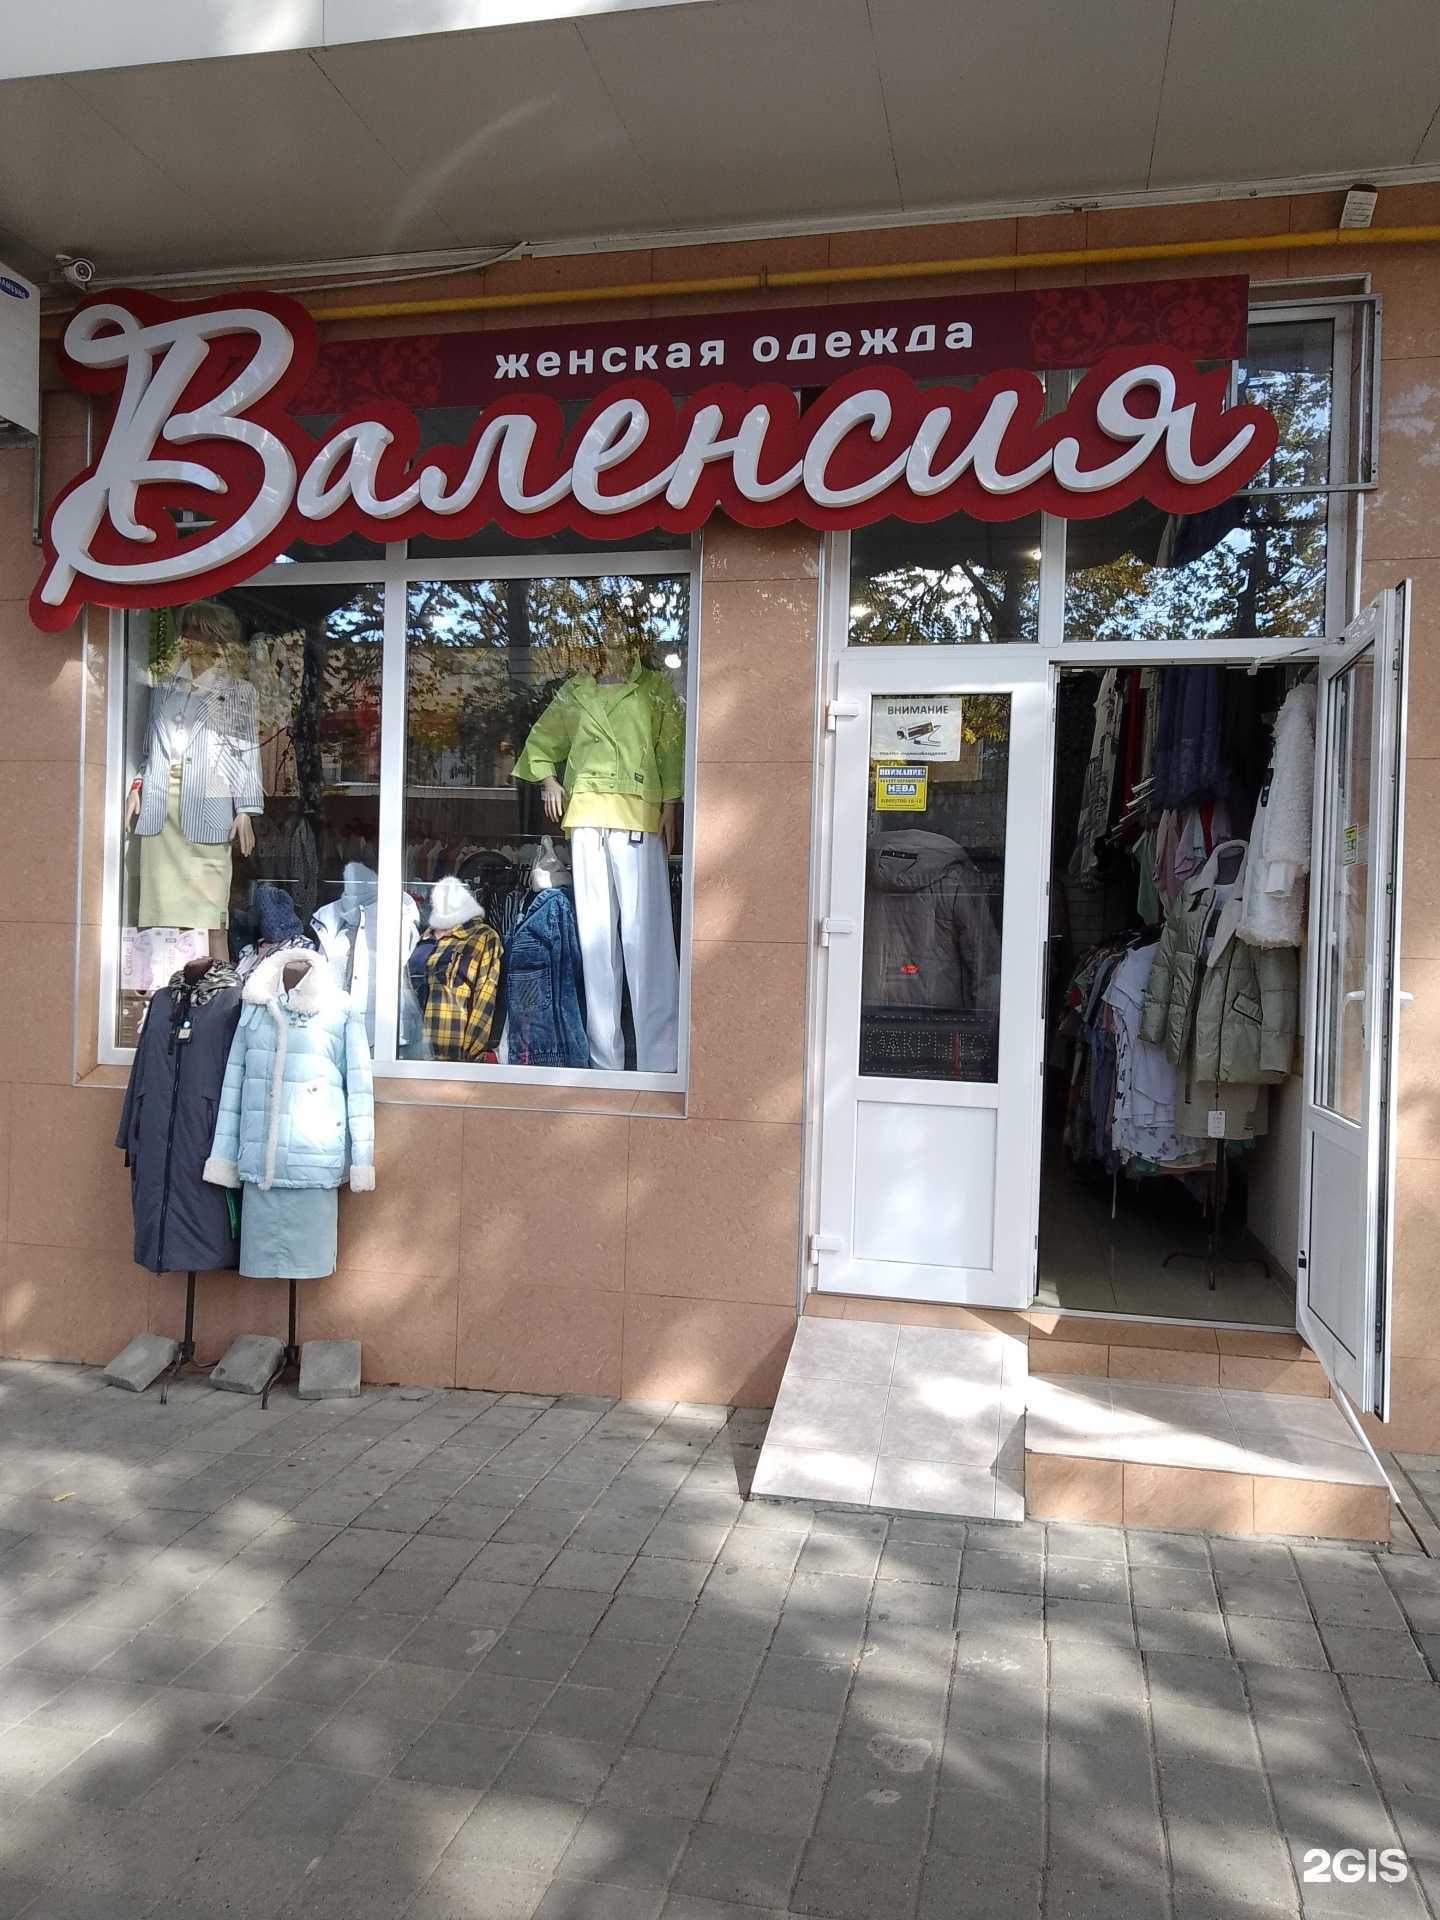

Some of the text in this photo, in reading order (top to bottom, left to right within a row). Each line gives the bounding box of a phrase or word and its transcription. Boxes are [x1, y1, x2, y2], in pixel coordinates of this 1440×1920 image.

[494, 321, 973, 379] женская одежда
[41, 303, 1256, 606] Валенсия
[888, 705, 949, 715] ВНИМАНИЕ
